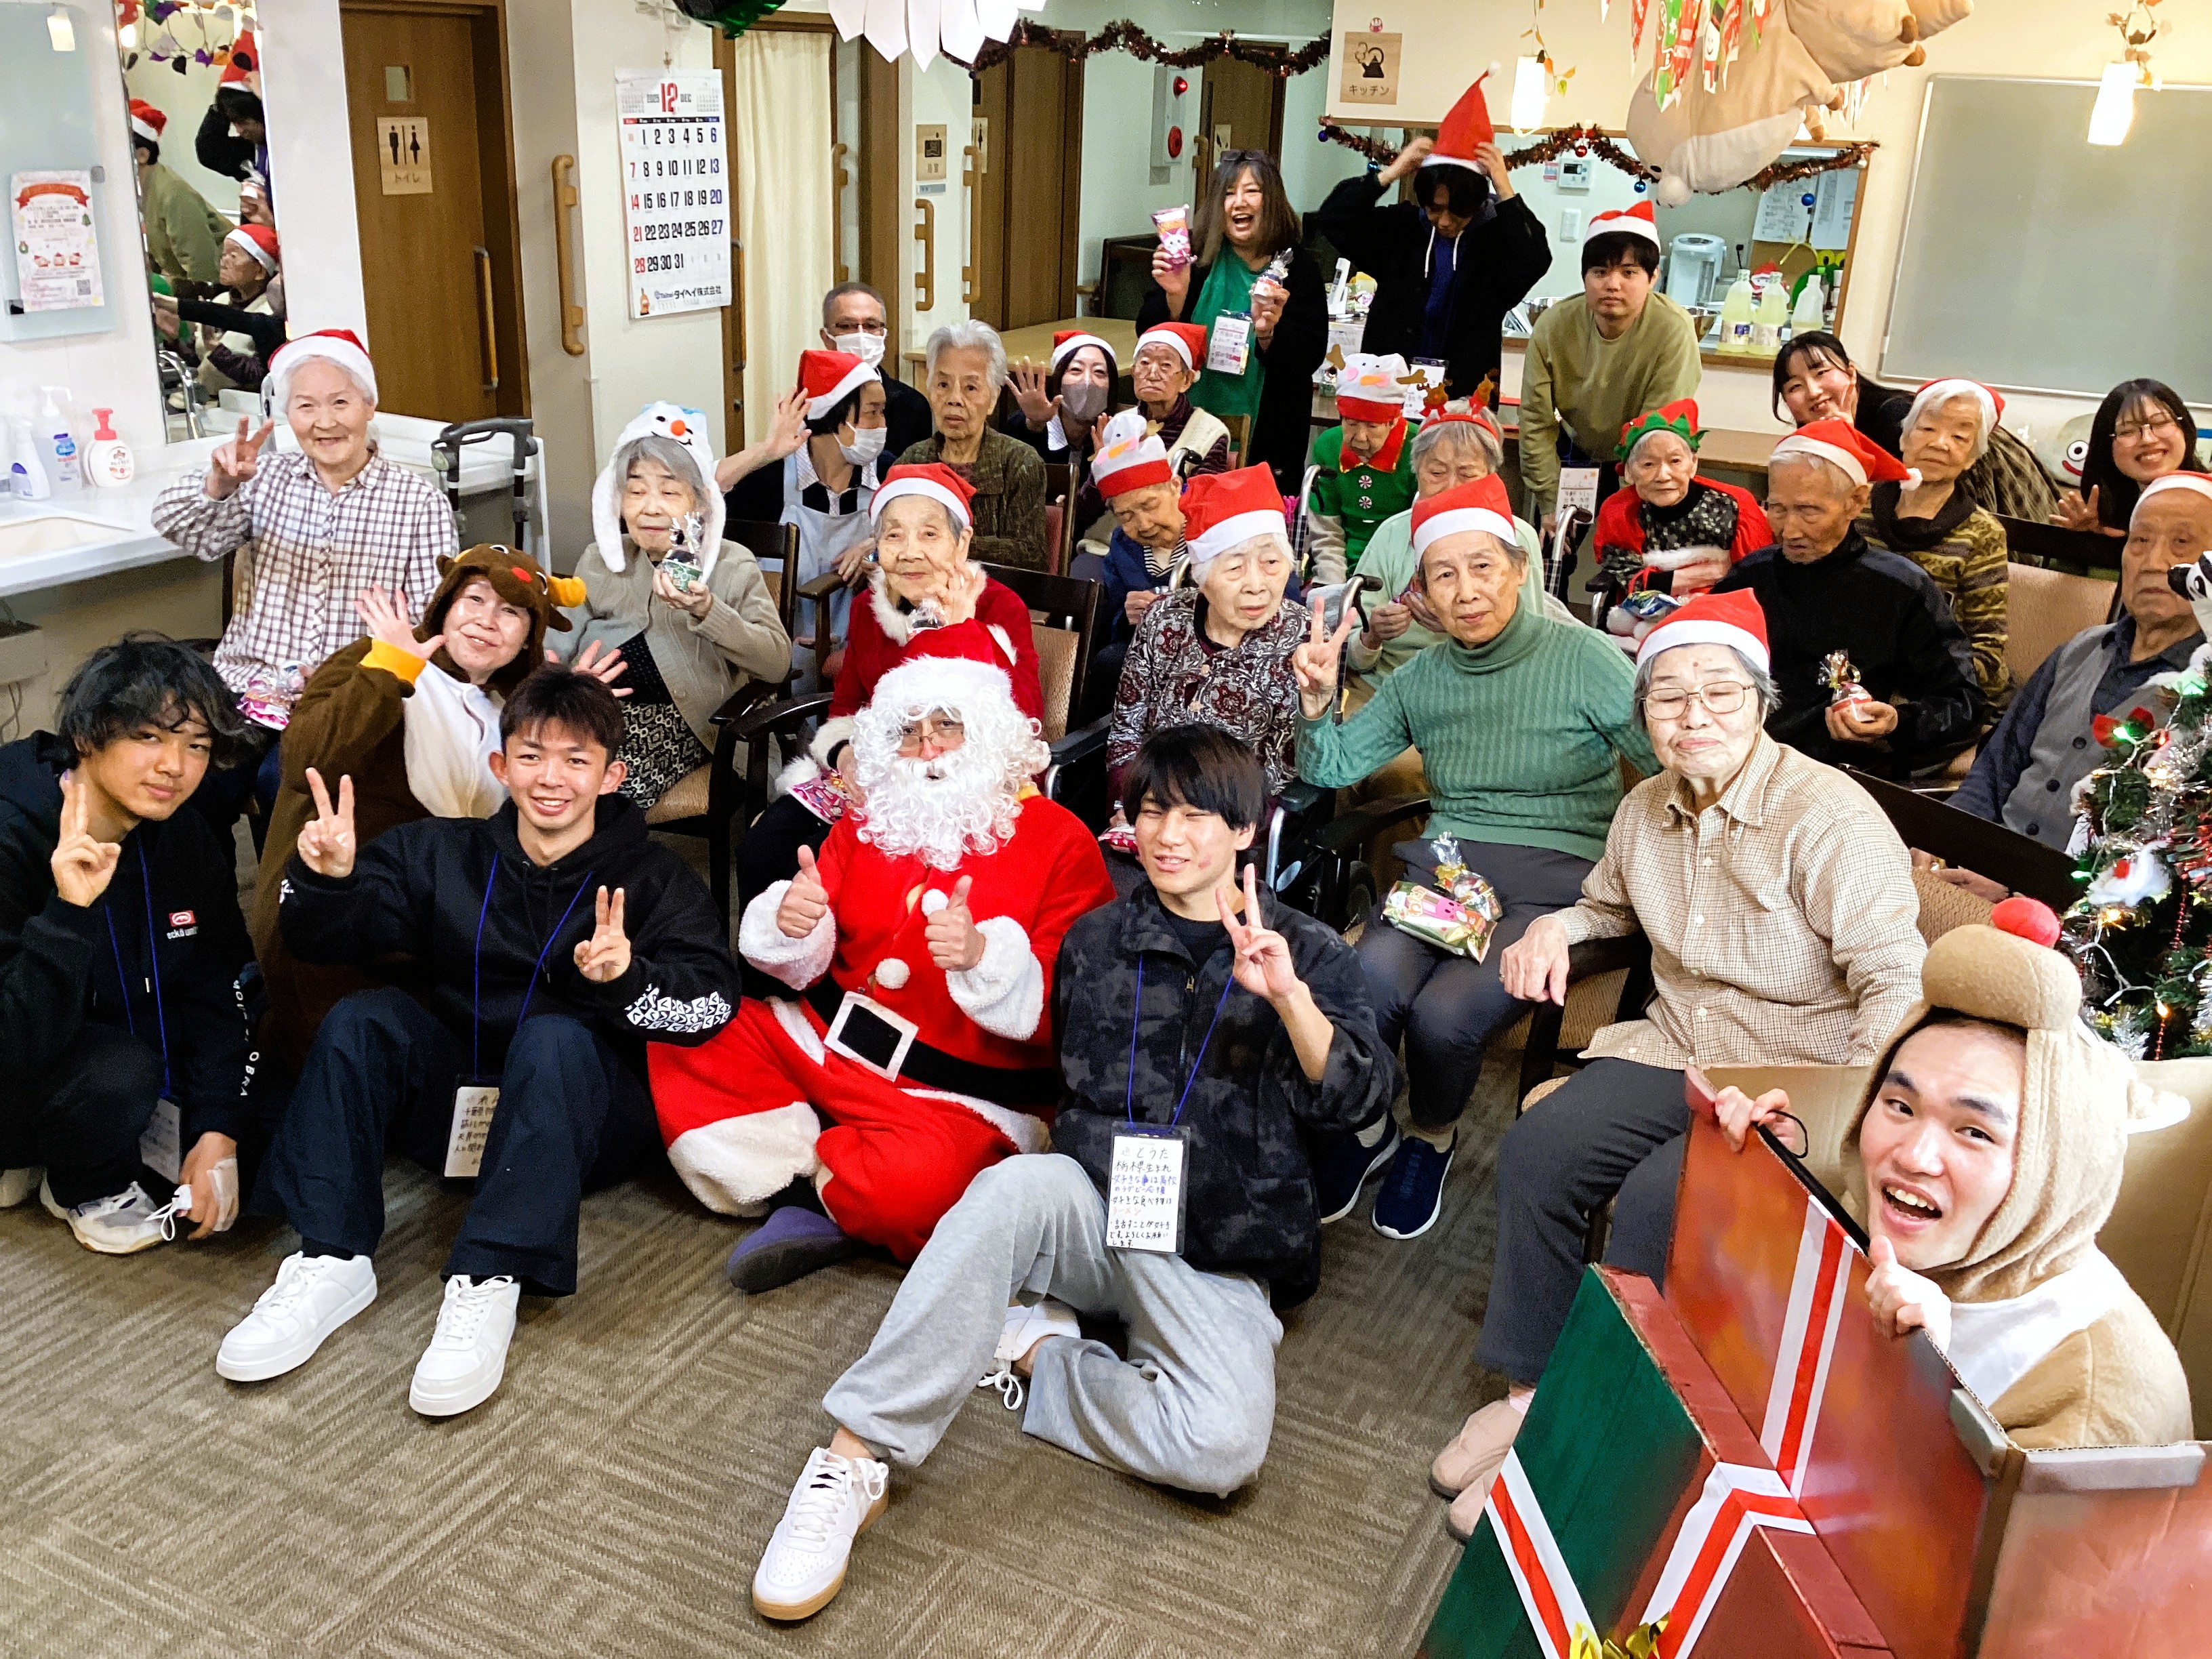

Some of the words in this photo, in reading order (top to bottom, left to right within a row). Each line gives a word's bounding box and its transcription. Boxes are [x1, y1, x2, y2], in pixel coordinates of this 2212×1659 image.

[661, 83, 678, 112] 12
[1349, 84, 1389, 96] キッチン
[642, 129, 646, 145] 1
[655, 129, 661, 144] 2
[668, 128, 674, 144] 3
[683, 128, 689, 143] 4
[697, 127, 703, 143] 5
[711, 127, 716, 143] 6
[630, 162, 635, 178] 7
[643, 161, 649, 177] 8
[657, 161, 663, 176] 9
[668, 160, 678, 176] 10
[683, 159, 691, 175] 11
[697, 159, 705, 174] 12
[710, 159, 719, 173] 13
[394, 173, 419, 184] トイレ
[631, 194, 639, 210] 14
[644, 193, 653, 209] 15
[657, 192, 666, 207] 16
[671, 192, 679, 207] 17
[684, 190, 693, 206] 18
[698, 190, 707, 205] 19
[710, 189, 722, 204] 20
[634, 226, 642, 242] 21
[645, 225, 657, 241] 22
[658, 224, 670, 239] 23
[672, 222, 682, 238] 24
[685, 222, 696, 237] 25
[698, 220, 709, 236] 26
[712, 220, 723, 234] 27
[635, 258, 645, 273] 28
[647, 256, 659, 272] 29
[661, 255, 672, 270] 30
[674, 253, 684, 268] 31
[674, 286, 721, 299] タイヘイ株式会社
